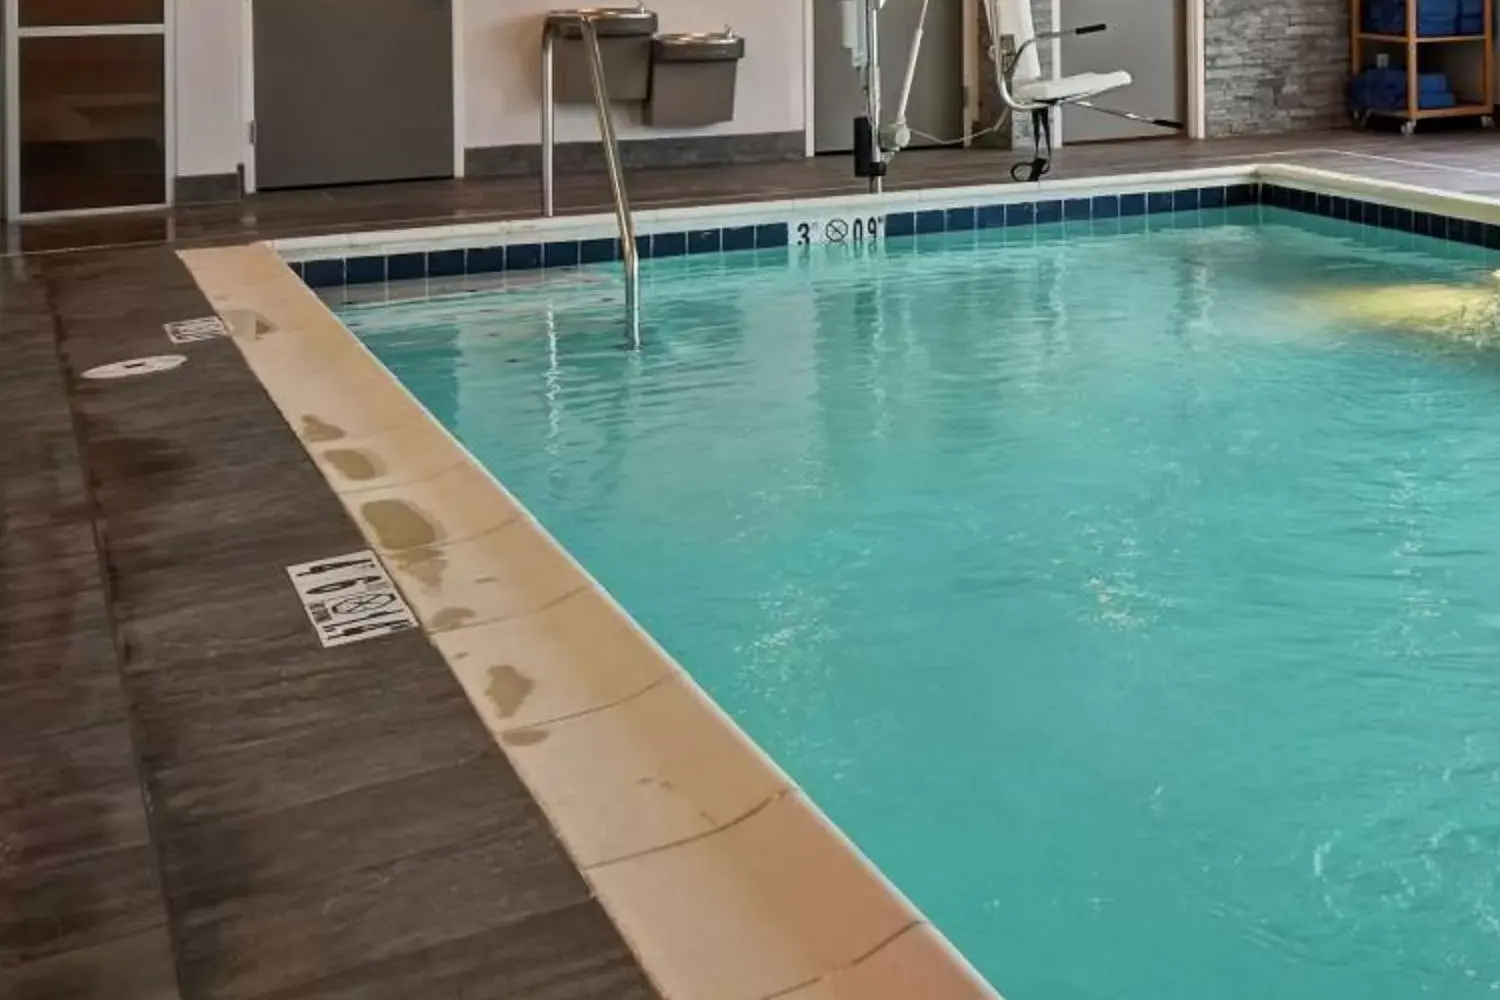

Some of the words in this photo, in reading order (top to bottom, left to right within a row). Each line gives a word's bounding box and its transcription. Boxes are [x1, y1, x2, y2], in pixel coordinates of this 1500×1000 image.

[797, 223, 810, 246] 3
[295, 559, 374, 577] 4
[305, 576, 383, 595] 6
